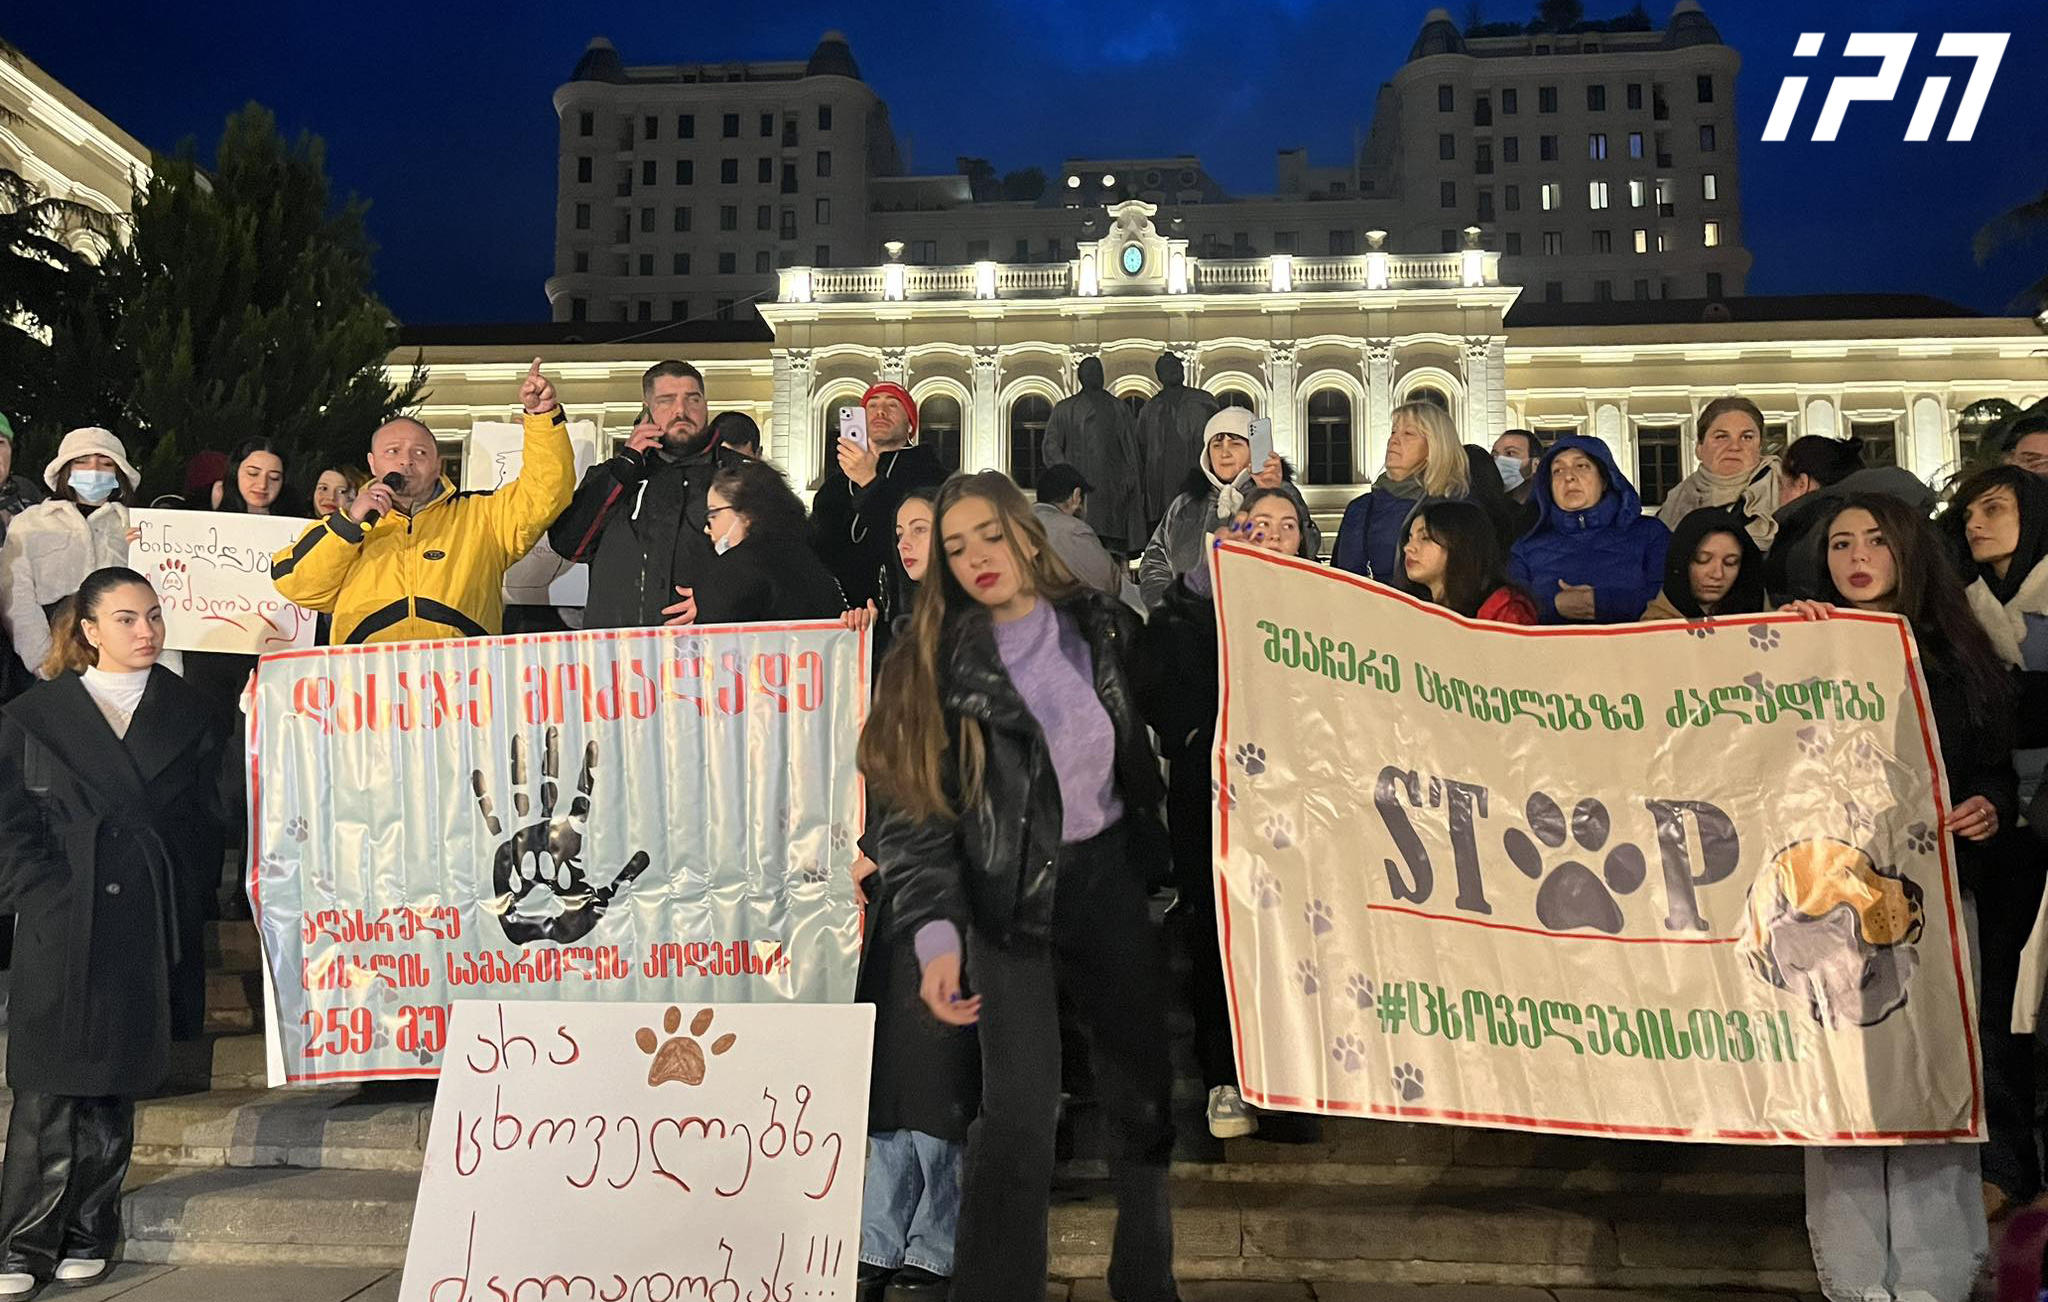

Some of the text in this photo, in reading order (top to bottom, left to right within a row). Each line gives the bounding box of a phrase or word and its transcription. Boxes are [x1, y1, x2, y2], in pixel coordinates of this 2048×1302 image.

[139, 521, 297, 574] წინააღმდეგ
[145, 573, 312, 643] ოძალადეს
[293, 651, 824, 735] დასაჯე მოძალადე
[1256, 619, 1885, 731] შეაჩერე ცხოველებზე ძალადობა
[303, 905, 461, 944] აღასრულე
[447, 944, 628, 985] სამართლის
[300, 1004, 452, 1058] 259 მუ
[467, 1003, 580, 1074] არა
[455, 1084, 842, 1199] ცხოველებზე
